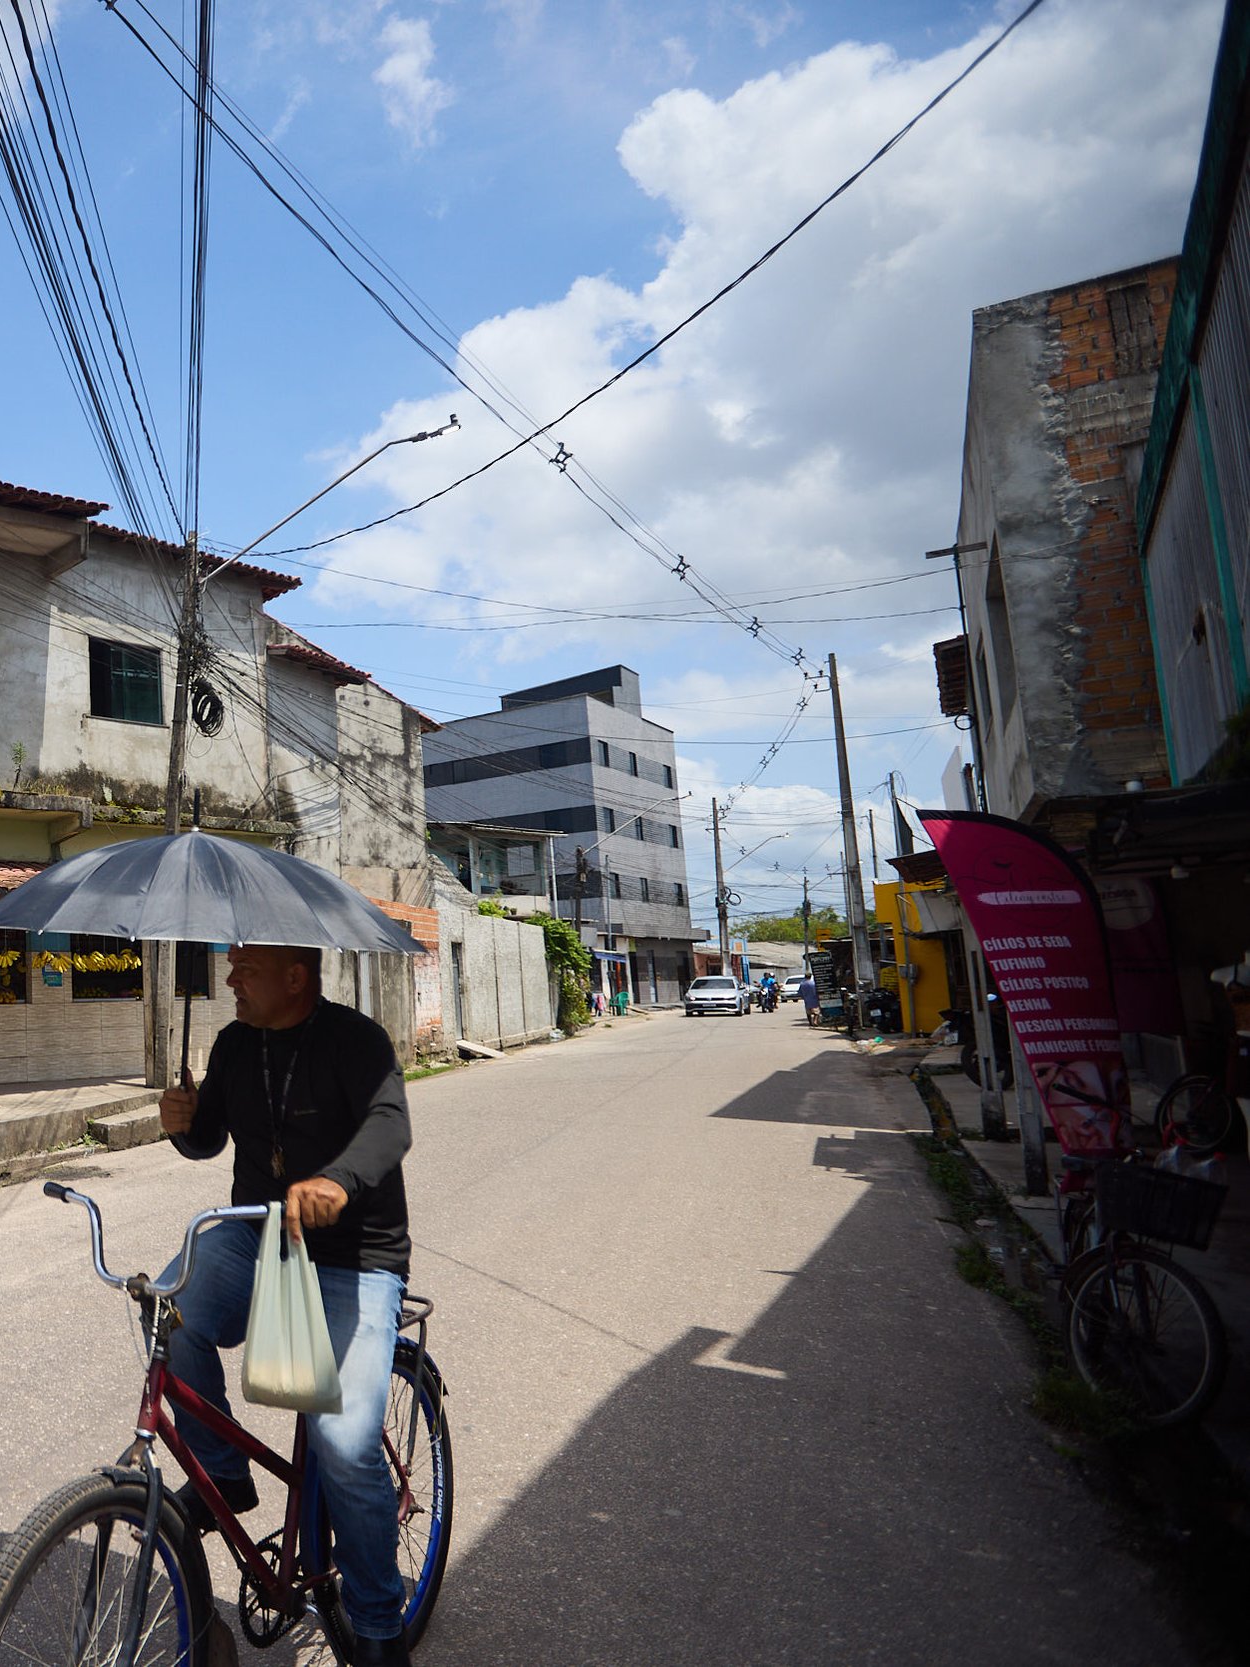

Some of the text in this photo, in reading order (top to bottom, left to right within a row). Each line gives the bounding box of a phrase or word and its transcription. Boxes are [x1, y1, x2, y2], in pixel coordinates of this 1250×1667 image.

[983, 935, 1072, 952] CÍLIOS DE SEDA
[990, 956, 1046, 972] TUFINHO
[999, 975, 1090, 992] CÍLIOS POSTIÇO
[1006, 998, 1052, 1012] HENNA
[1015, 1018, 1064, 1034] DESIGN
[1023, 1039, 1088, 1055] MANICURE
[1088, 1039, 1096, 1052] E
